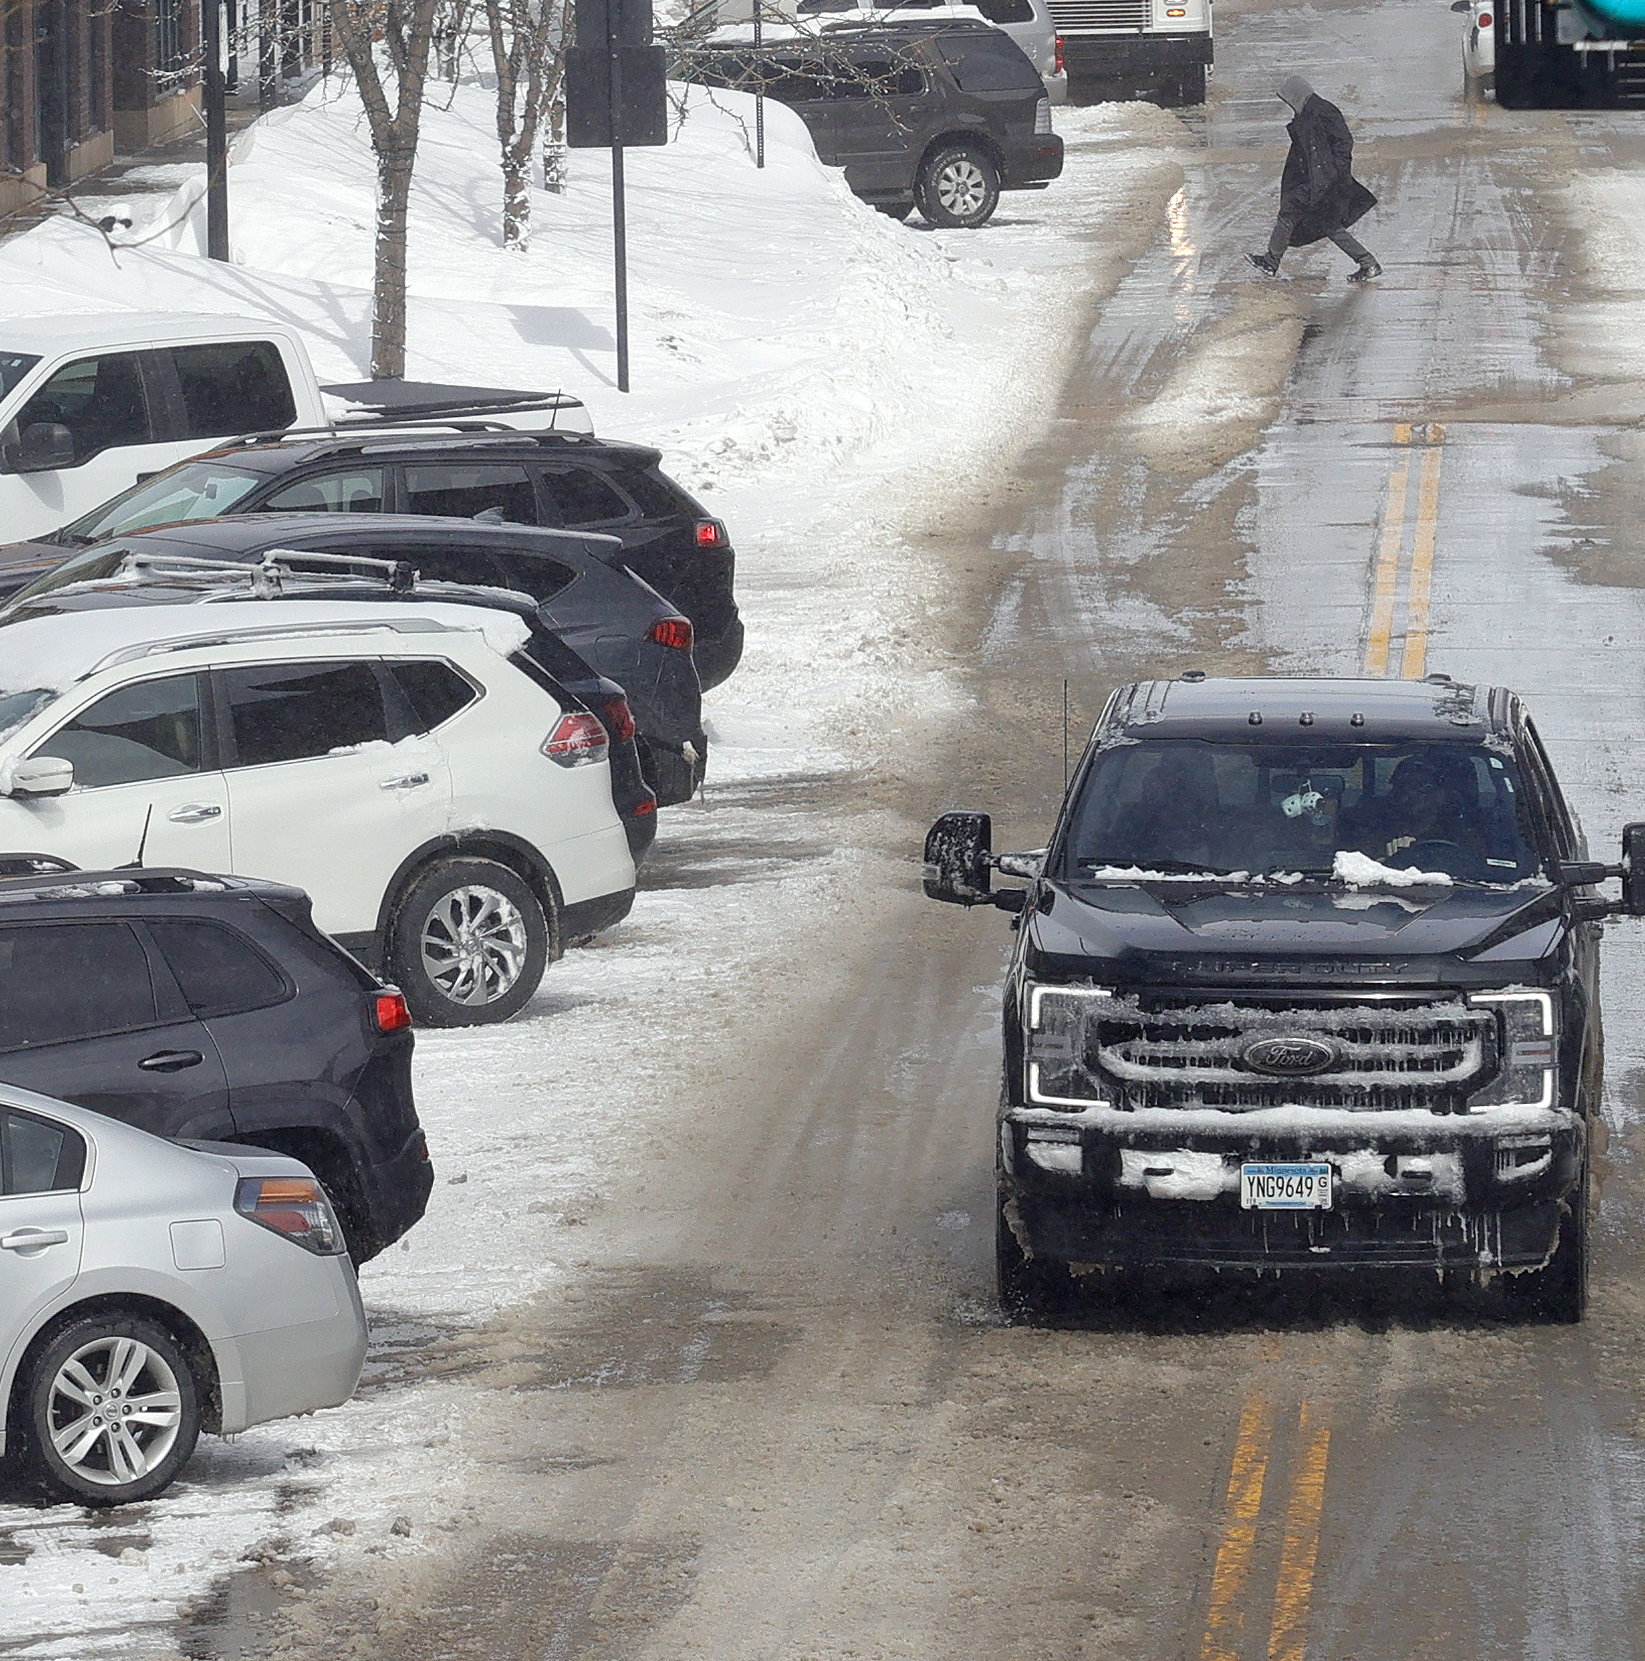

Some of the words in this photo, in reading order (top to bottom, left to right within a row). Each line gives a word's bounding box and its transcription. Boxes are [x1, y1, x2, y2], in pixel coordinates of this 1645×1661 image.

[1309, 961, 1409, 975] DUTY
[1266, 1045, 1313, 1065] Ford
[1265, 1166, 1307, 1174] Minnesota
[1247, 1176, 1314, 1198] YNG9649
[1318, 1177, 1328, 1188] G
